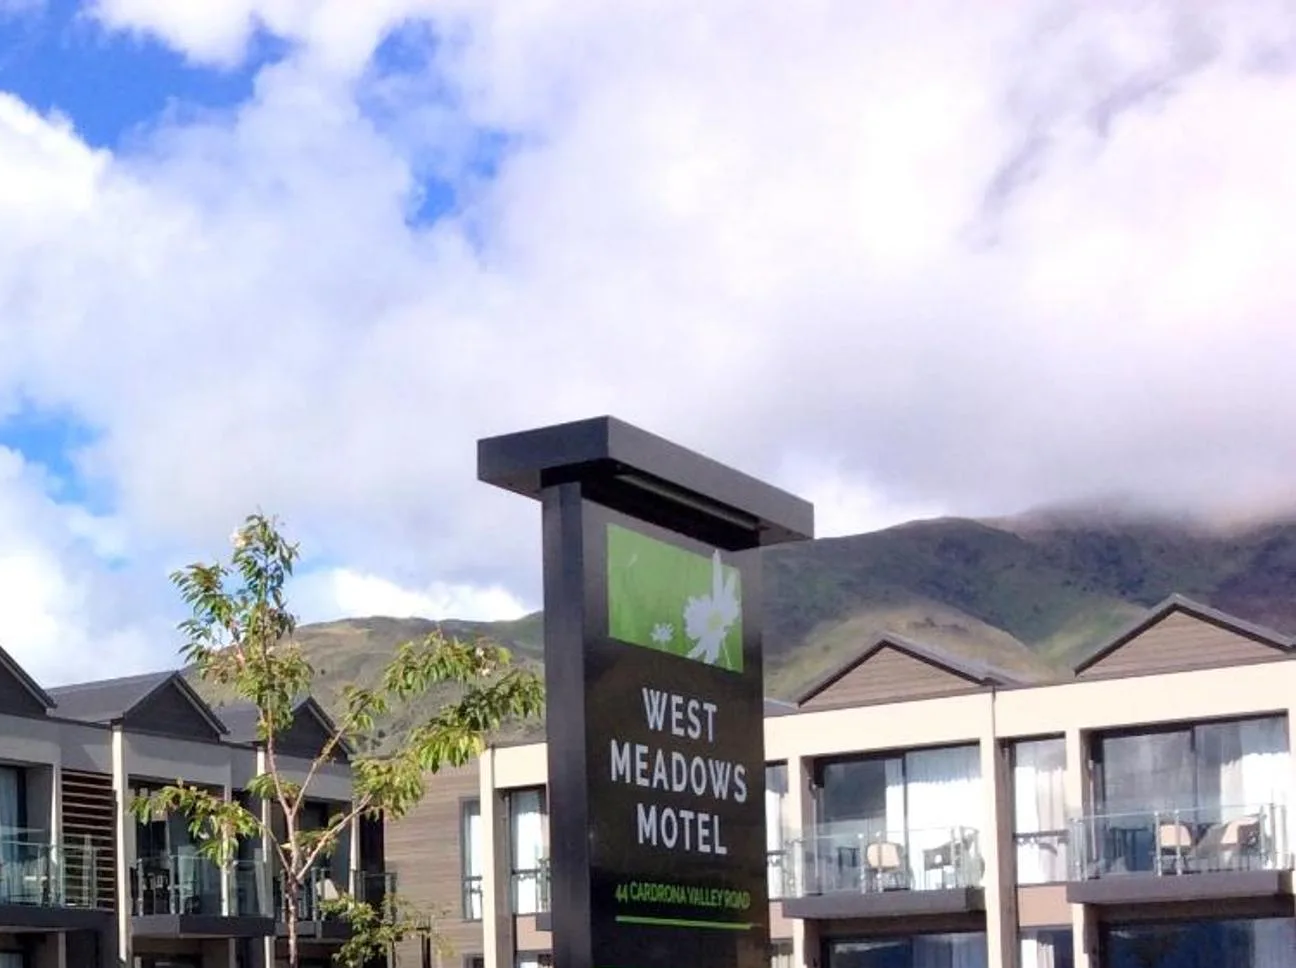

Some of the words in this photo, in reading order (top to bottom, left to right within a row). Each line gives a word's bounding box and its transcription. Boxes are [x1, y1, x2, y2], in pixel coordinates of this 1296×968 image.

[642, 687, 717, 742] WEST
[610, 739, 747, 804] MEADOWS
[637, 802, 728, 855] MOTEL
[615, 884, 628, 903] 44
[724, 888, 751, 909] ROAD
